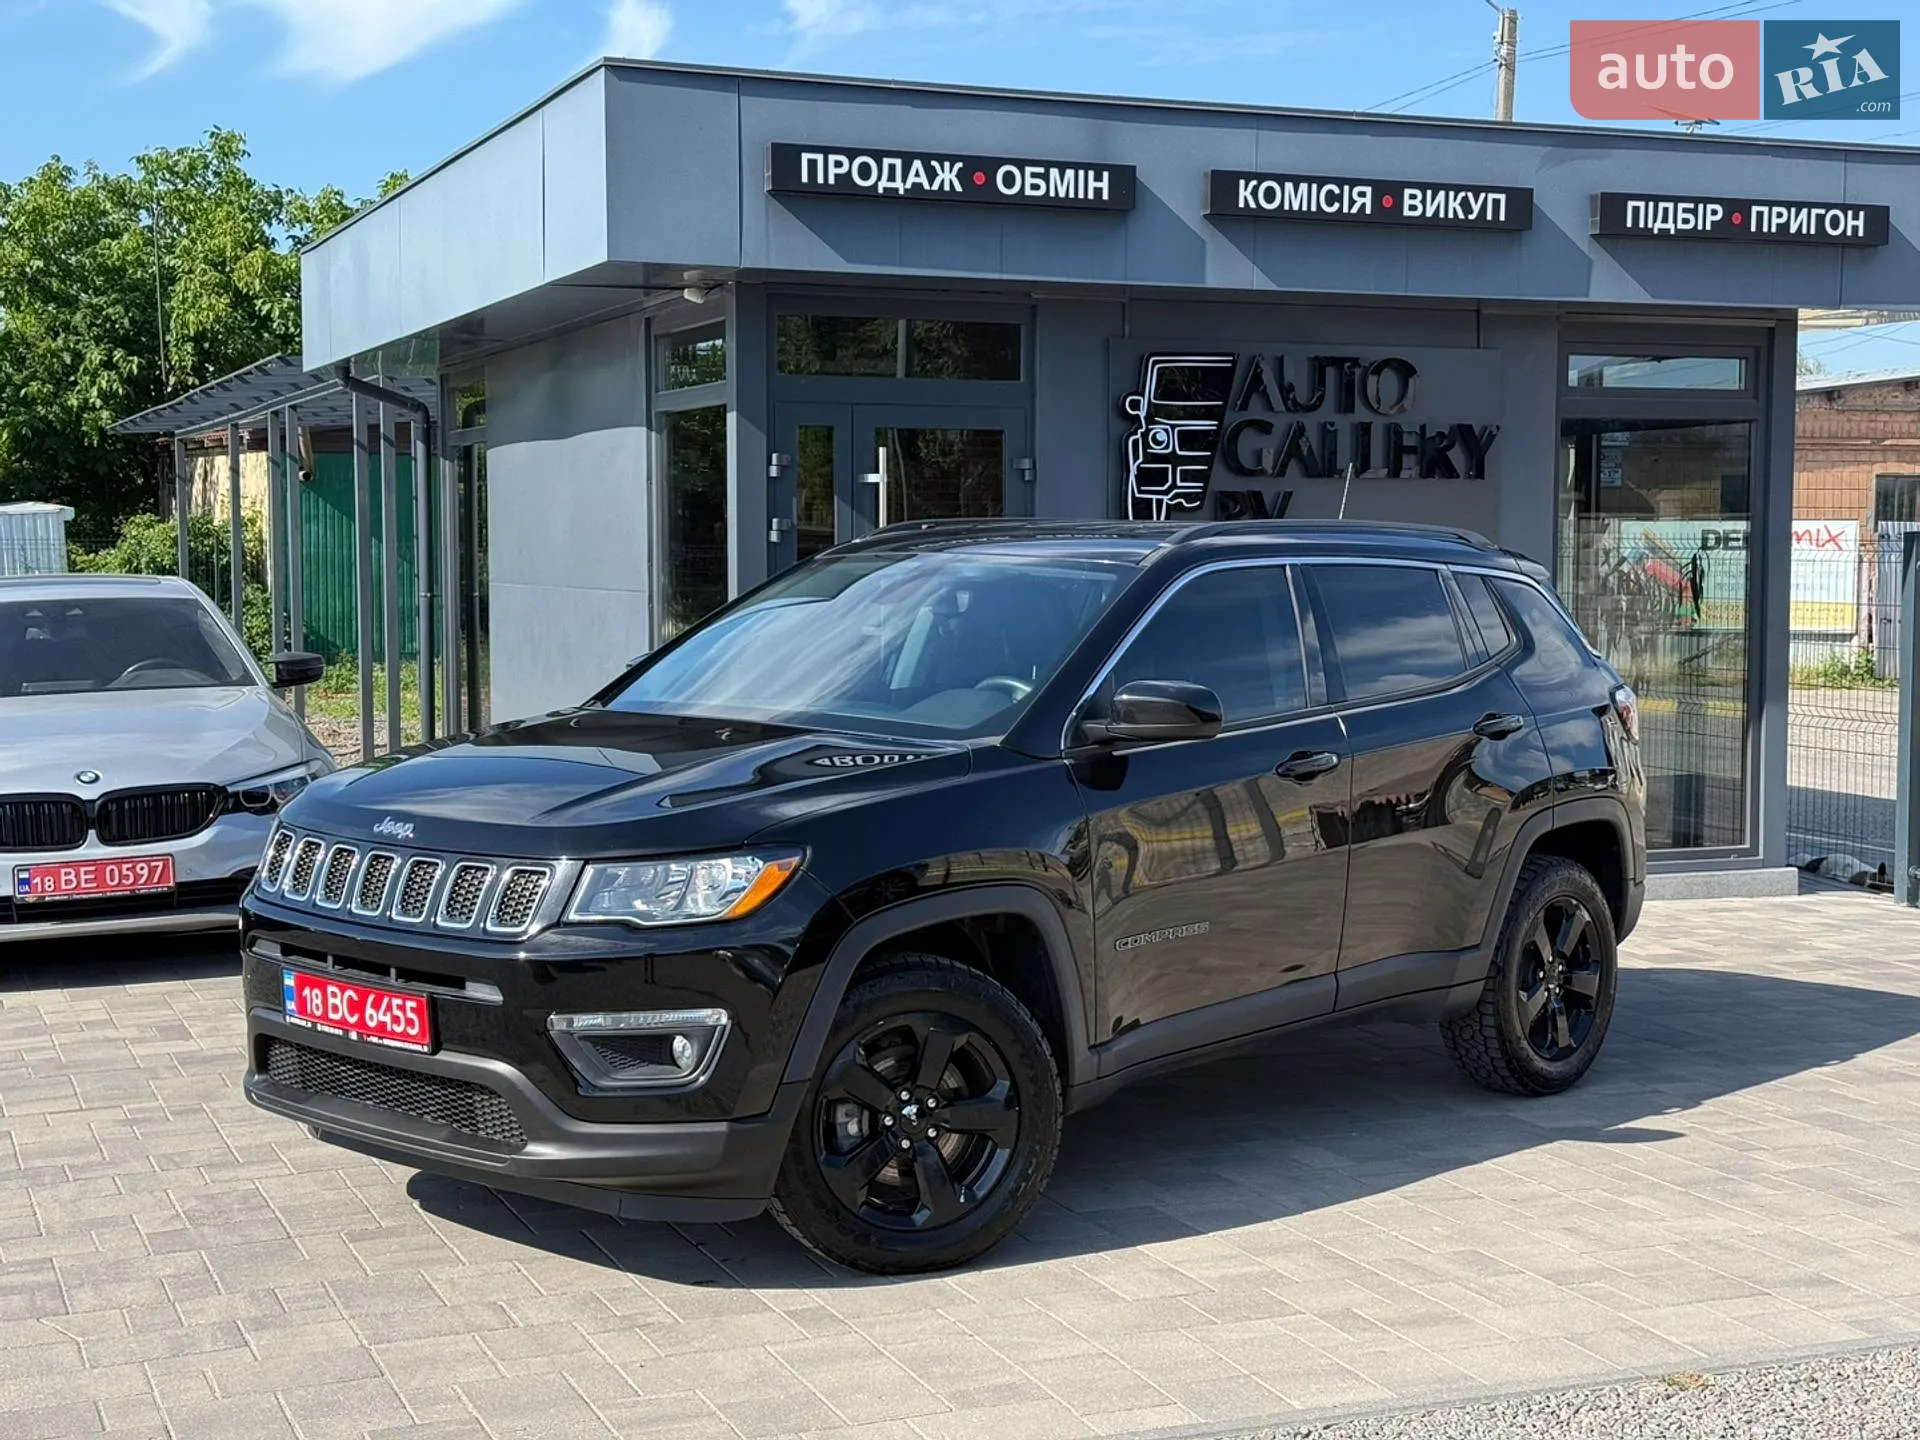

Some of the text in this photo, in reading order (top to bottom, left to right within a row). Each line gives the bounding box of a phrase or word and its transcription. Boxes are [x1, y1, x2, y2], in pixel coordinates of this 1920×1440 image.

[801, 152, 1109, 200] ПРОДАЖ ОБМІН
[1238, 179, 1507, 221] КОМІСІЯ ВИКУП
[1626, 200, 1865, 237] ПІДБІР ПРИГОН
[1234, 353, 1418, 415] AUTO
[1223, 419, 1500, 480] GALLERY
[31, 860, 164, 893] 18 BE 0597
[302, 986, 323, 1017] 18
[327, 984, 359, 1024] BC
[365, 993, 420, 1036] 6455
